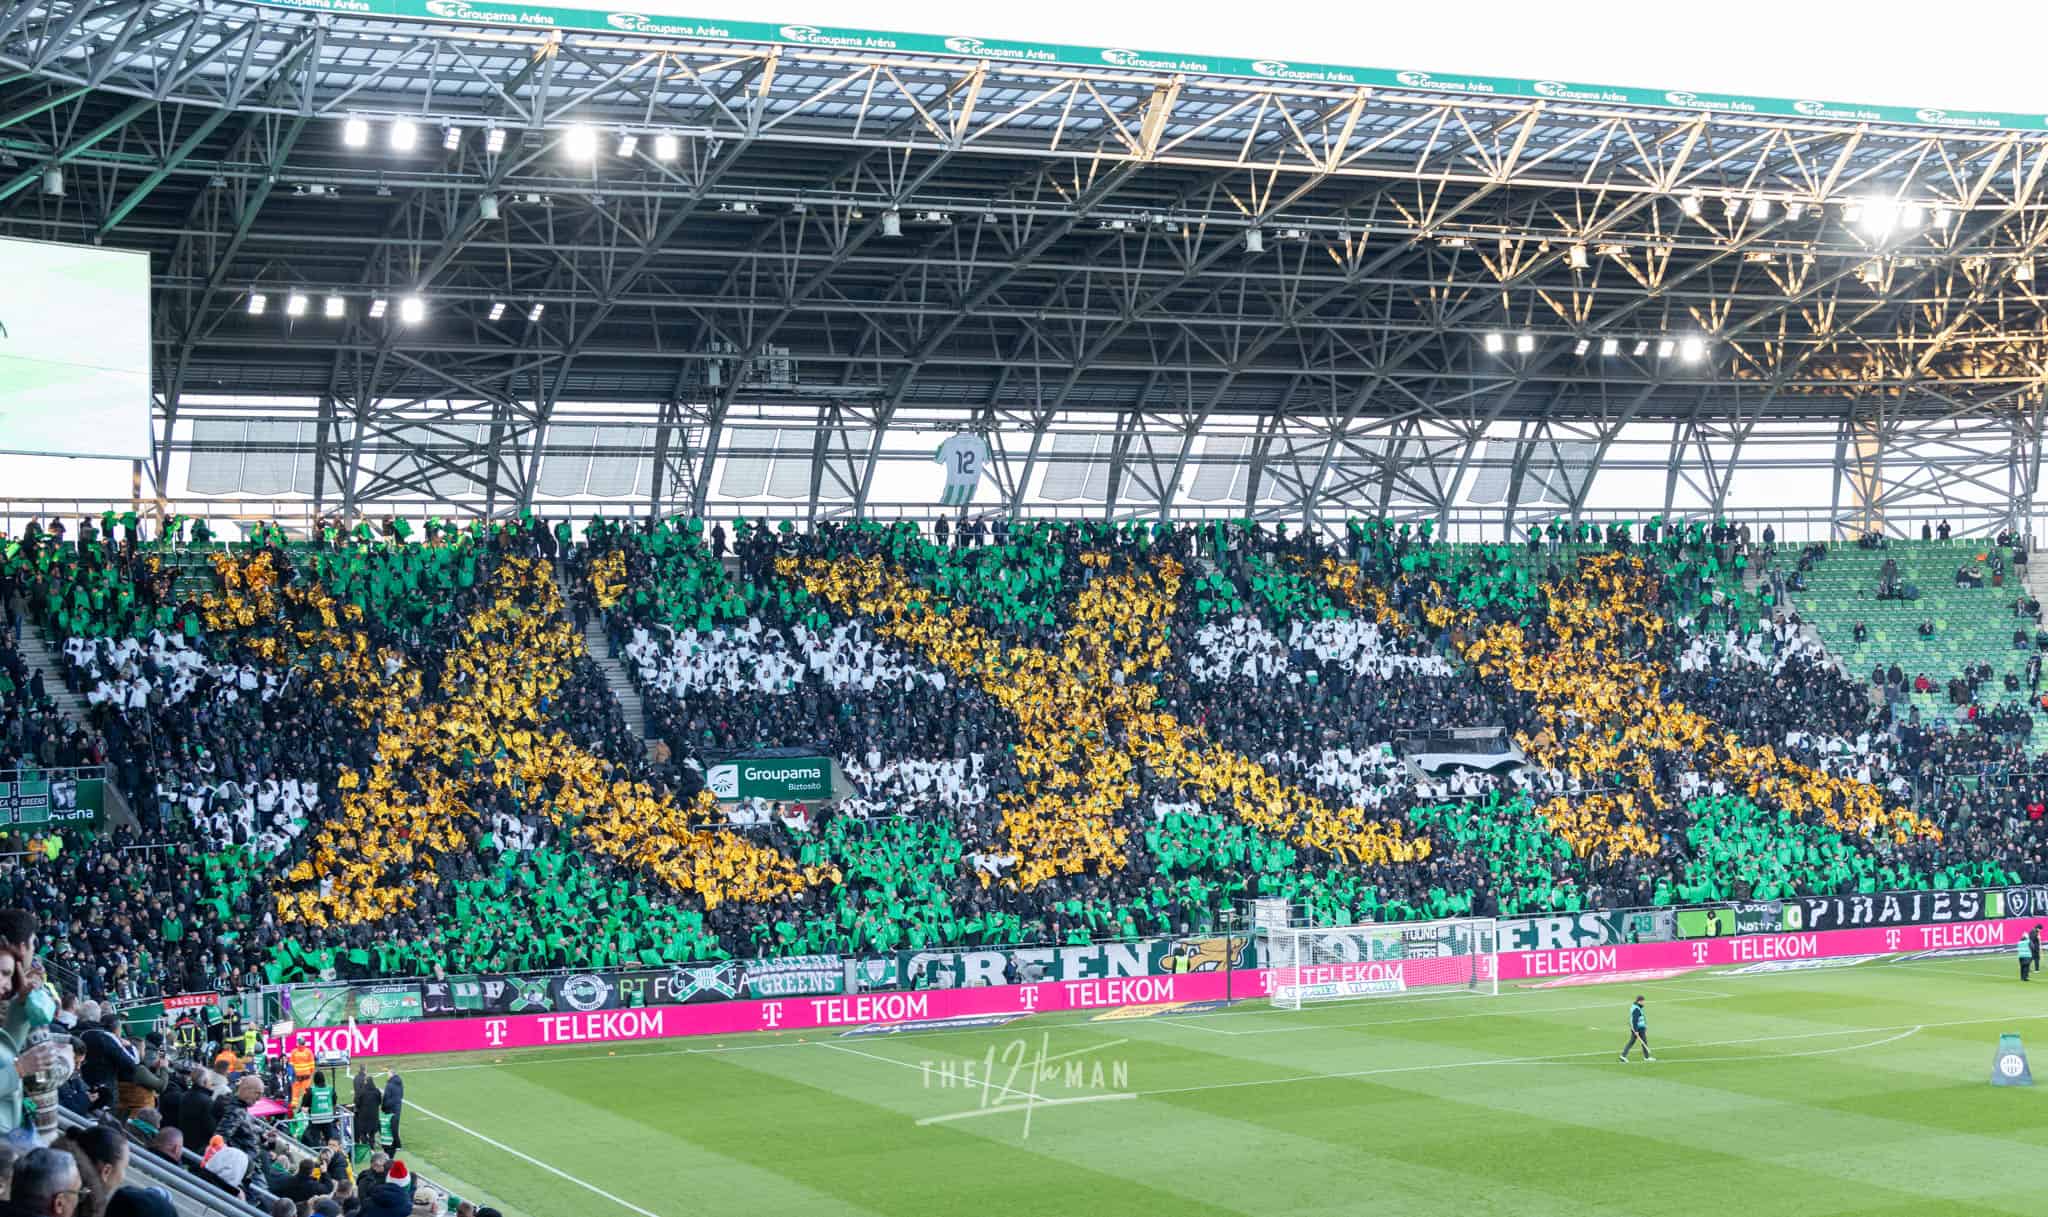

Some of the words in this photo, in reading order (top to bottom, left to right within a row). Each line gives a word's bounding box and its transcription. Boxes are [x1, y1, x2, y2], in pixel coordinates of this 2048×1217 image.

[457, 8, 517, 21] Groupama
[636, 21, 694, 34] Groupama
[808, 33, 862, 46] Groupama
[972, 45, 1024, 57] Groupama
[1127, 57, 1177, 69] Groupama
[1277, 68, 1325, 80] Groupama
[1420, 79, 1465, 90] Groupama
[1556, 89, 1600, 100] Groupama
[956, 450, 975, 474] 12
[744, 767, 821, 782] Groupama
[1806, 892, 1979, 927] PIRATES
[1737, 920, 1782, 932] Nostra
[1920, 923, 2004, 947] TELEKOM
[1729, 935, 1816, 960] TELEKOM
[1522, 949, 1616, 975] TELEKOM
[758, 971, 836, 995] GREENS
[1301, 964, 1403, 985] TELEKOM
[1065, 978, 1174, 1006] TELEKOM
[811, 994, 928, 1023] TELEKOM
[537, 1010, 663, 1042] TELEKOM
[263, 1027, 379, 1058] ELEKOM
